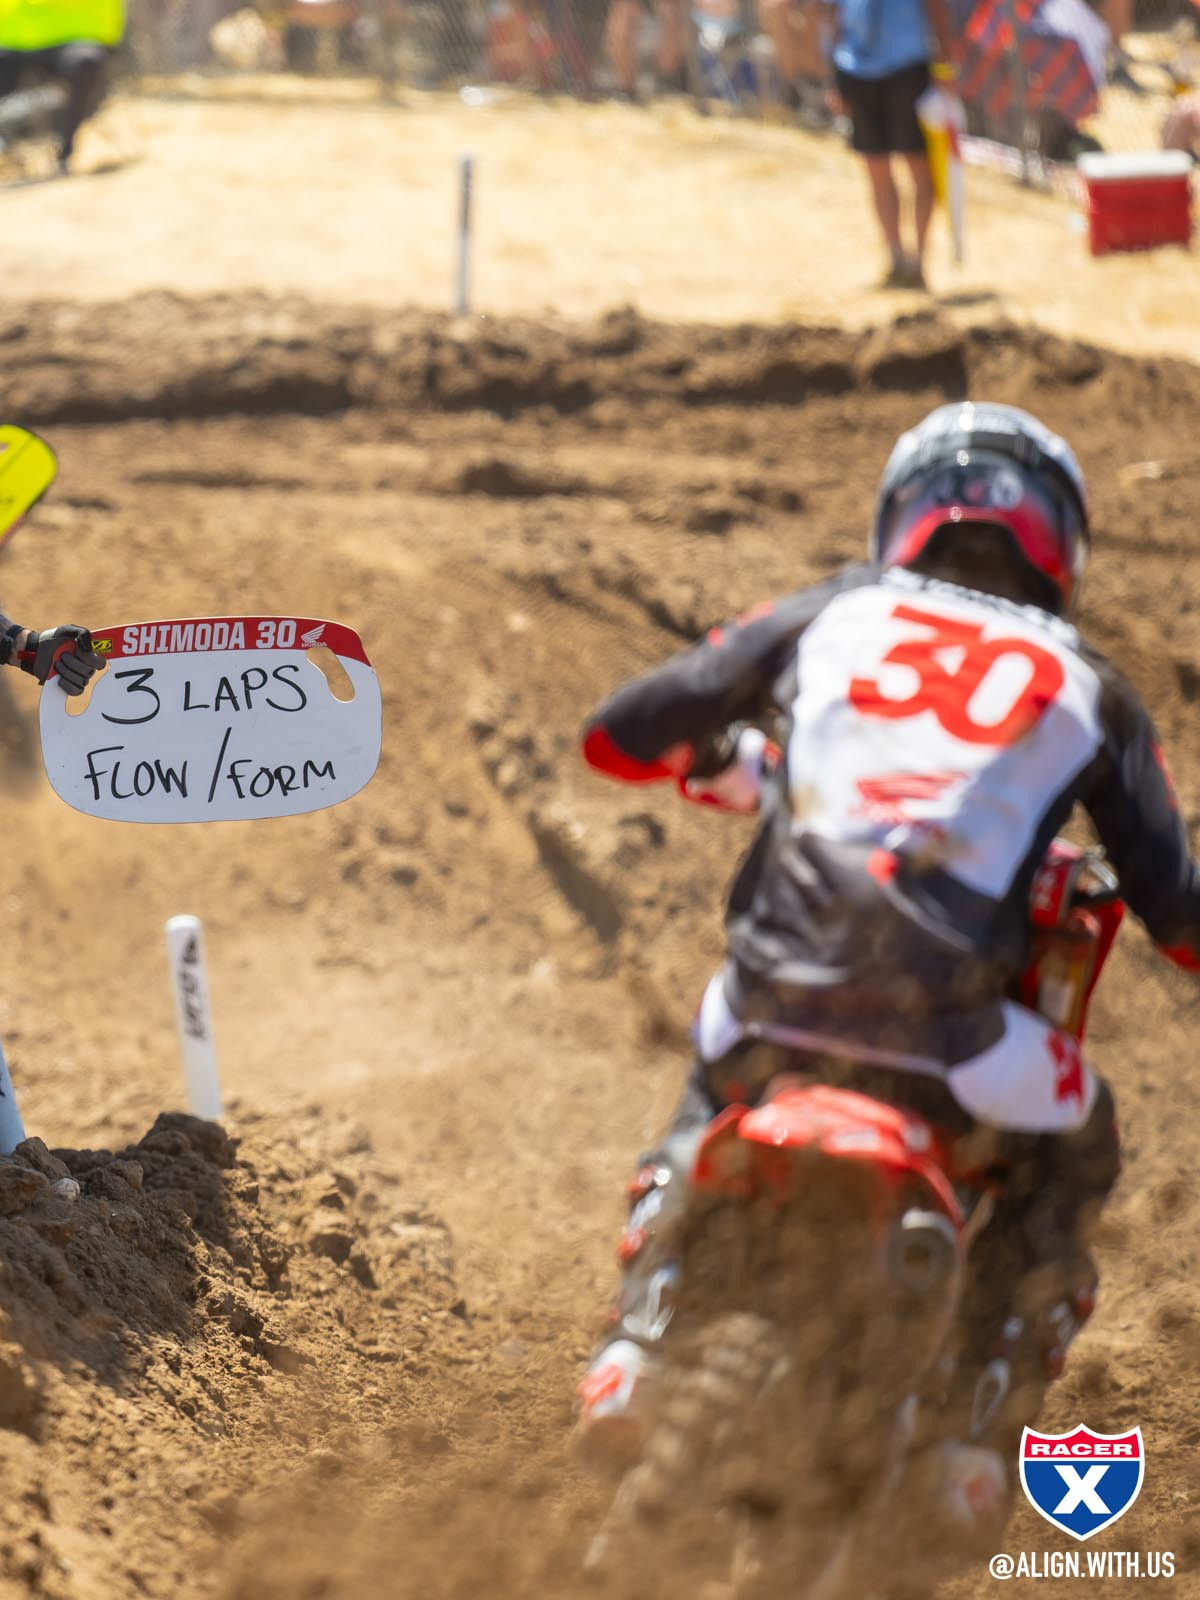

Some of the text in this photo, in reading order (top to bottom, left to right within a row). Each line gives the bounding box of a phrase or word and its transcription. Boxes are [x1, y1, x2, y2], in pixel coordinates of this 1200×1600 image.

[122, 621, 246, 655] SHIMODA
[256, 619, 297, 649] 30
[101, 664, 307, 725] 3 LAPS
[848, 603, 1065, 747] 30
[84, 745, 188, 801] FLOW
